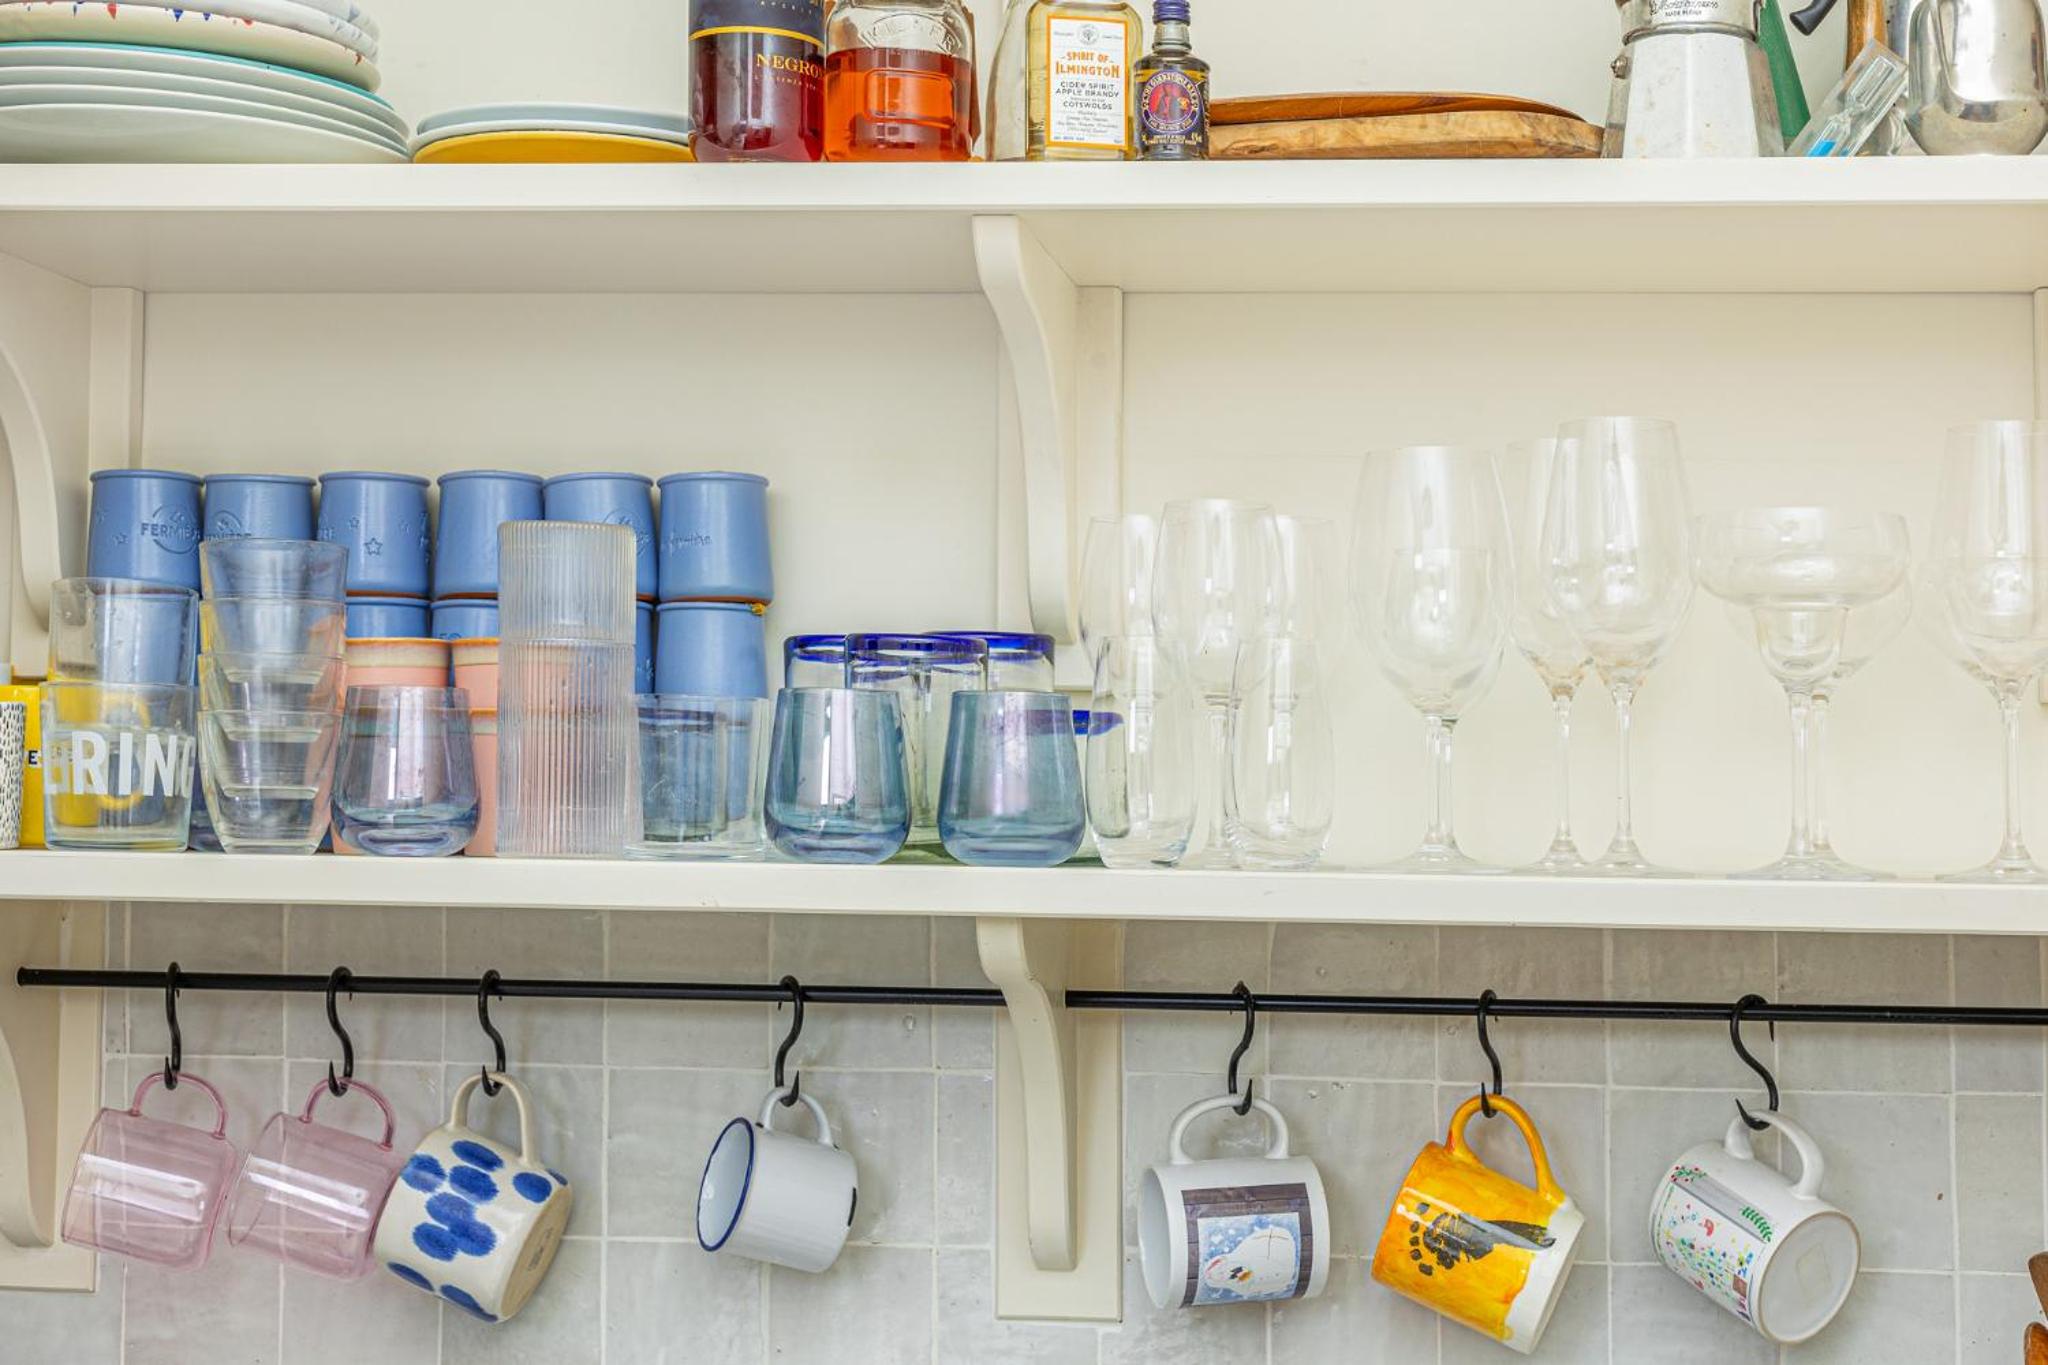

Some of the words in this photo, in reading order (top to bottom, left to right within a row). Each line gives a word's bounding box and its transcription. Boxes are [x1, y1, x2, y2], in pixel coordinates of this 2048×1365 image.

[1066, 51, 1094, 62] SPIRIT
[1097, 54, 1110, 63] OF
[1055, 60, 1120, 79] ILMINGTON
[1060, 81, 1086, 89] CIDER
[1088, 82, 1114, 91] SPIRIT
[1055, 87, 1082, 97] APPLE
[1085, 89, 1119, 98] BRANDY
[1063, 100, 1113, 110] COTSWOLDS
